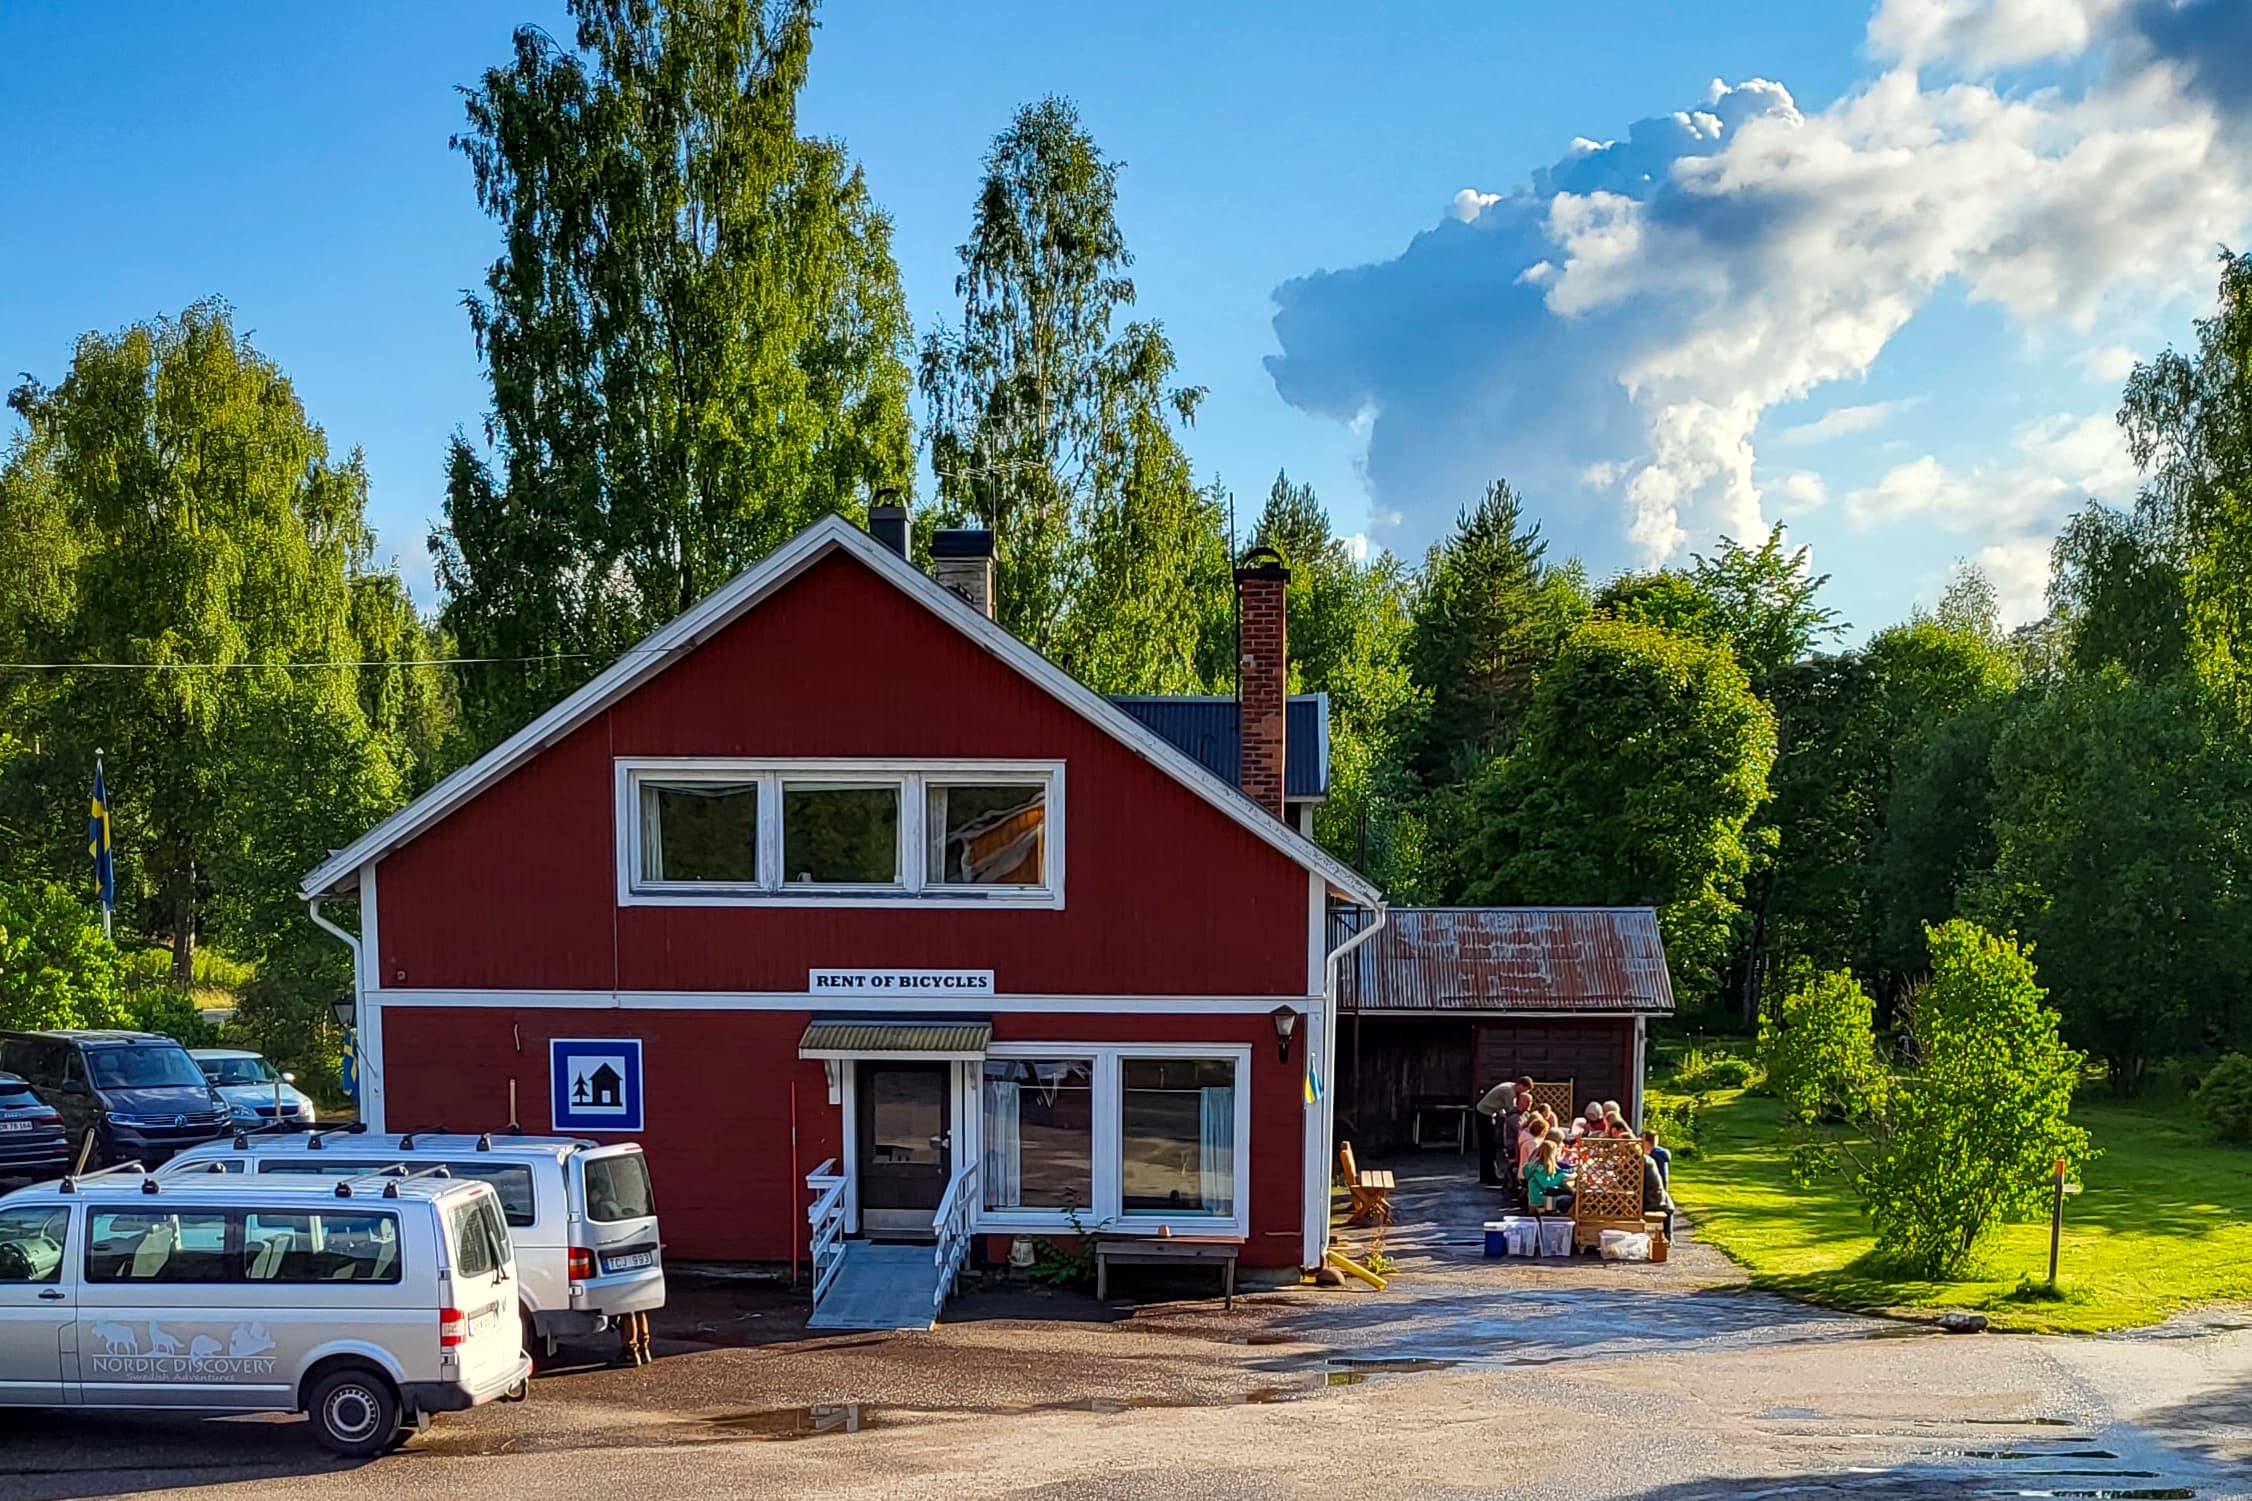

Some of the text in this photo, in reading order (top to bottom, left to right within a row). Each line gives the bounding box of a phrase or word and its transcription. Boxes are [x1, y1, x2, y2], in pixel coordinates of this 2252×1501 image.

[817, 976, 987, 988] RENT OF BICYCLES
[609, 1254, 649, 1268] TCJ 993
[93, 1358, 276, 1374] NORDIC DISCOVERY
